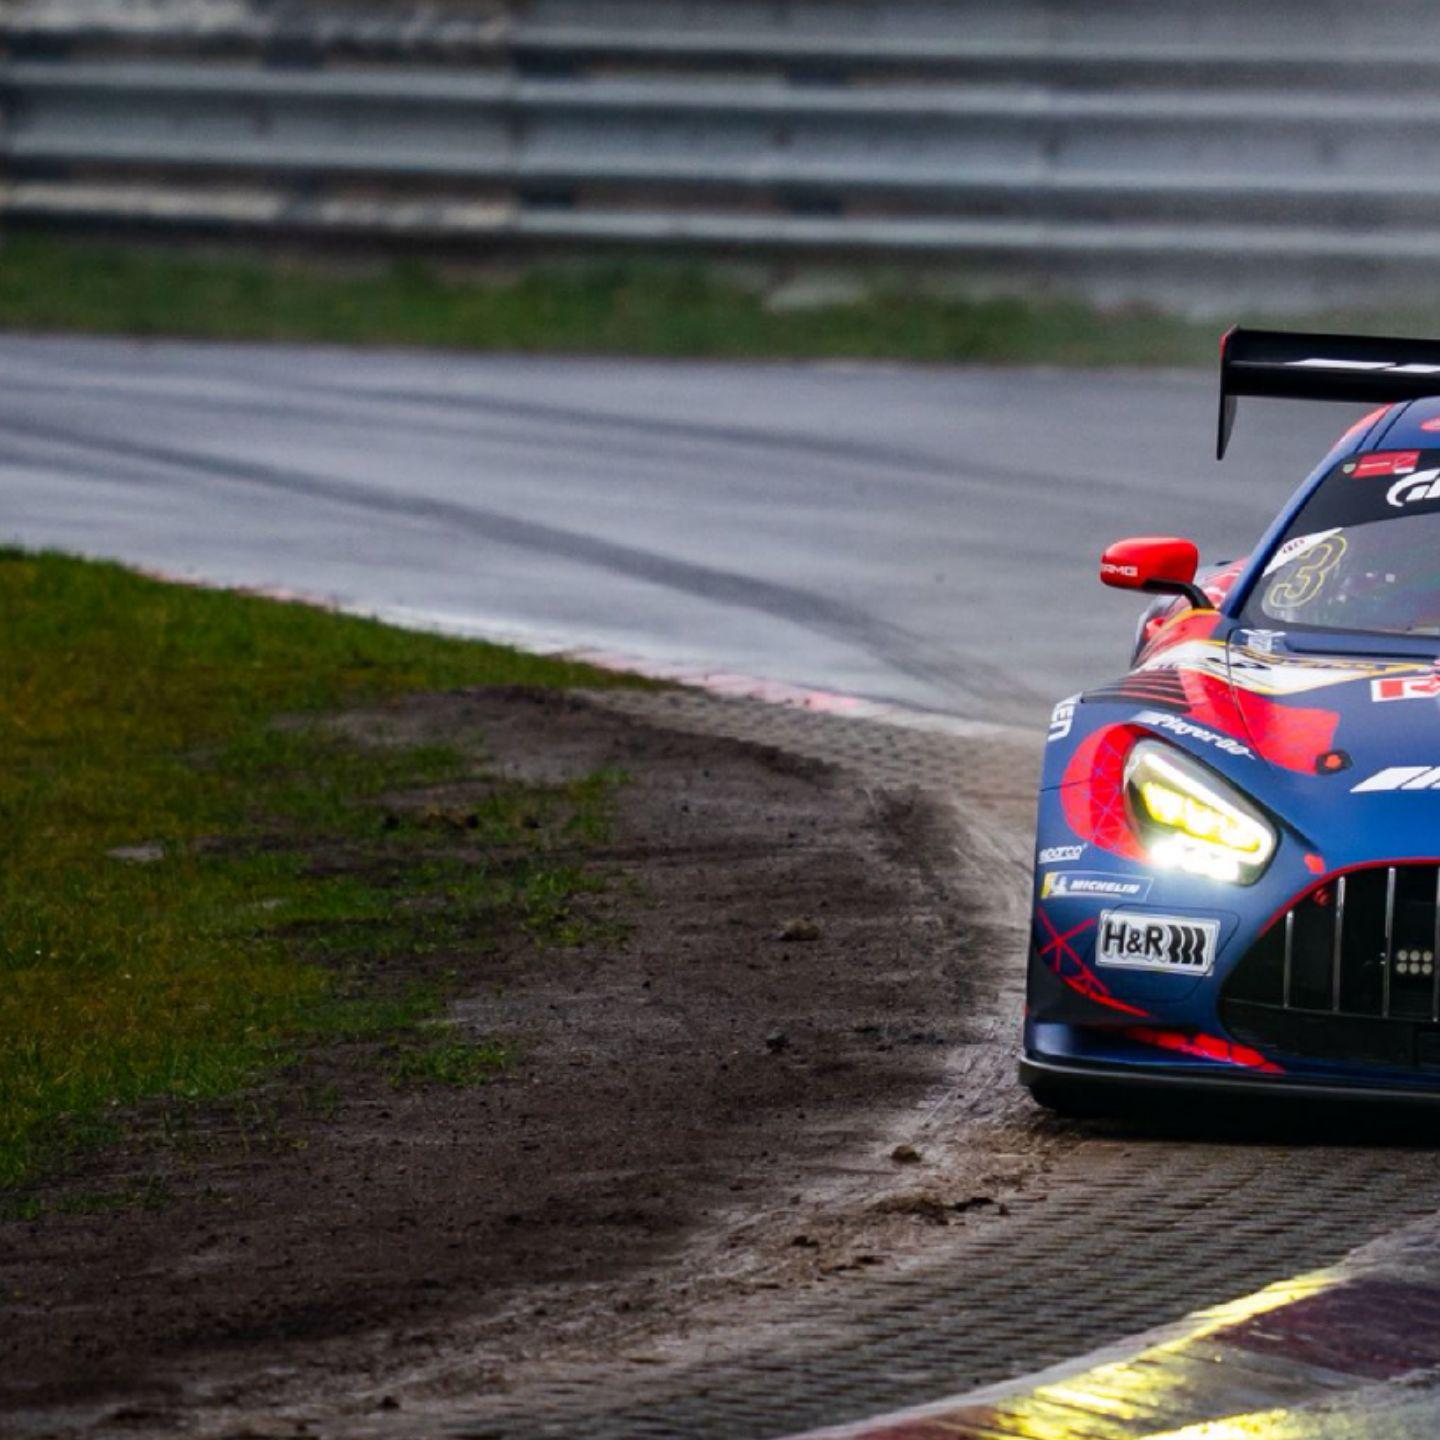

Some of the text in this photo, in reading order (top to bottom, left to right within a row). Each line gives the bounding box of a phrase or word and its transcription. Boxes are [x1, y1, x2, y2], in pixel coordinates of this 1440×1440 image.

[1269, 533, 1348, 609] 3
[1069, 878, 1142, 895] MICHELIN
[1102, 920, 1165, 957] H&R
